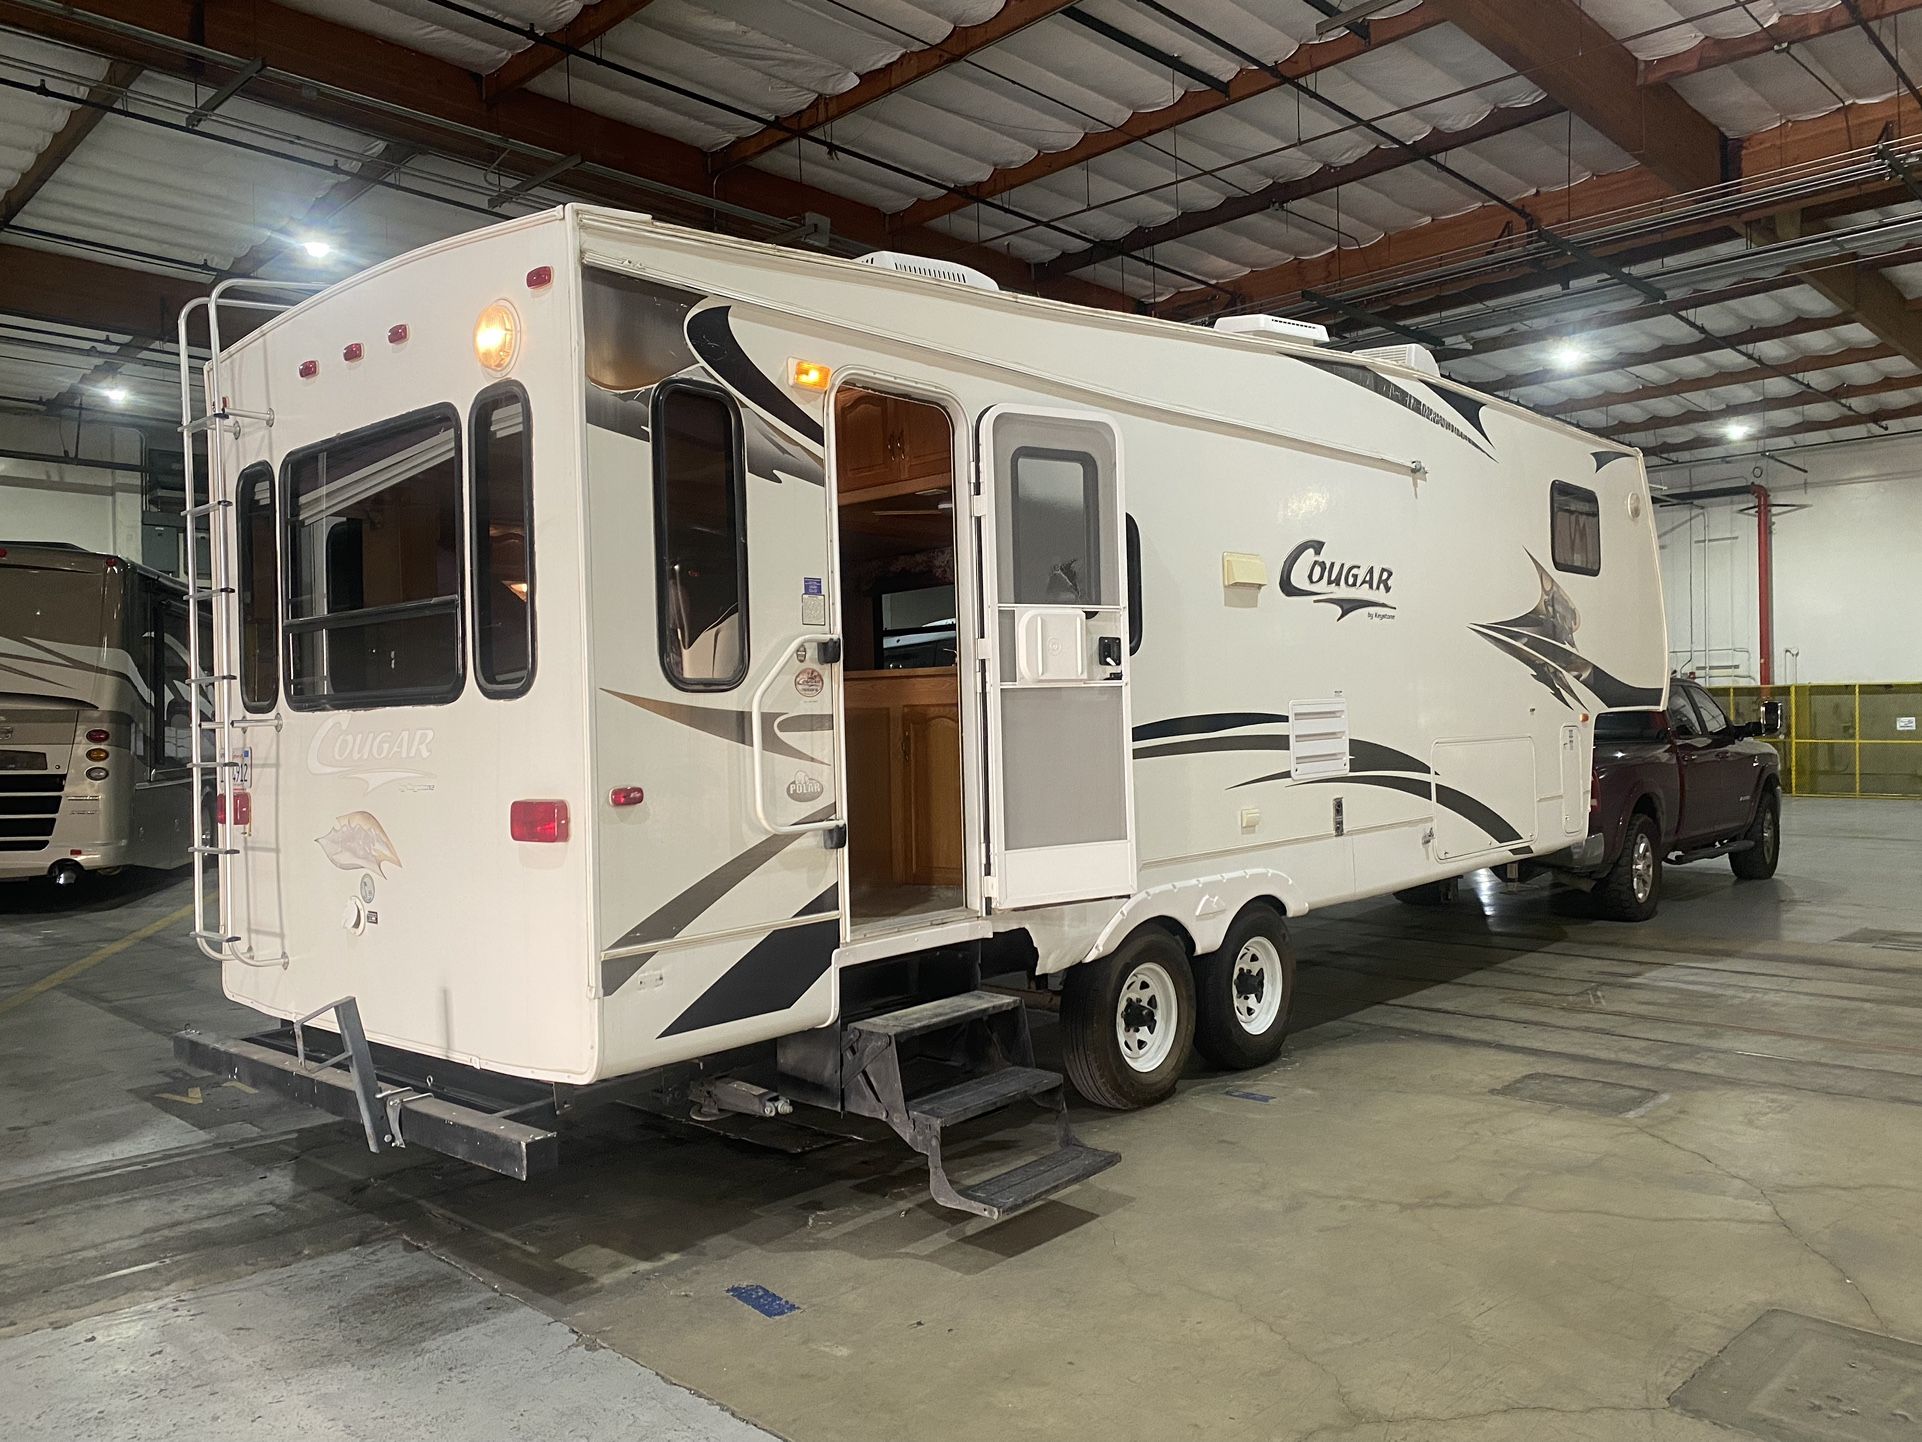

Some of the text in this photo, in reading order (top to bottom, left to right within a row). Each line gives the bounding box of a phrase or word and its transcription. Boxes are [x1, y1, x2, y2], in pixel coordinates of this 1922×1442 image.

[1279, 539, 1394, 597] COUGAR
[307, 713, 435, 775] COUGAR
[789, 782, 821, 794] POLAR
